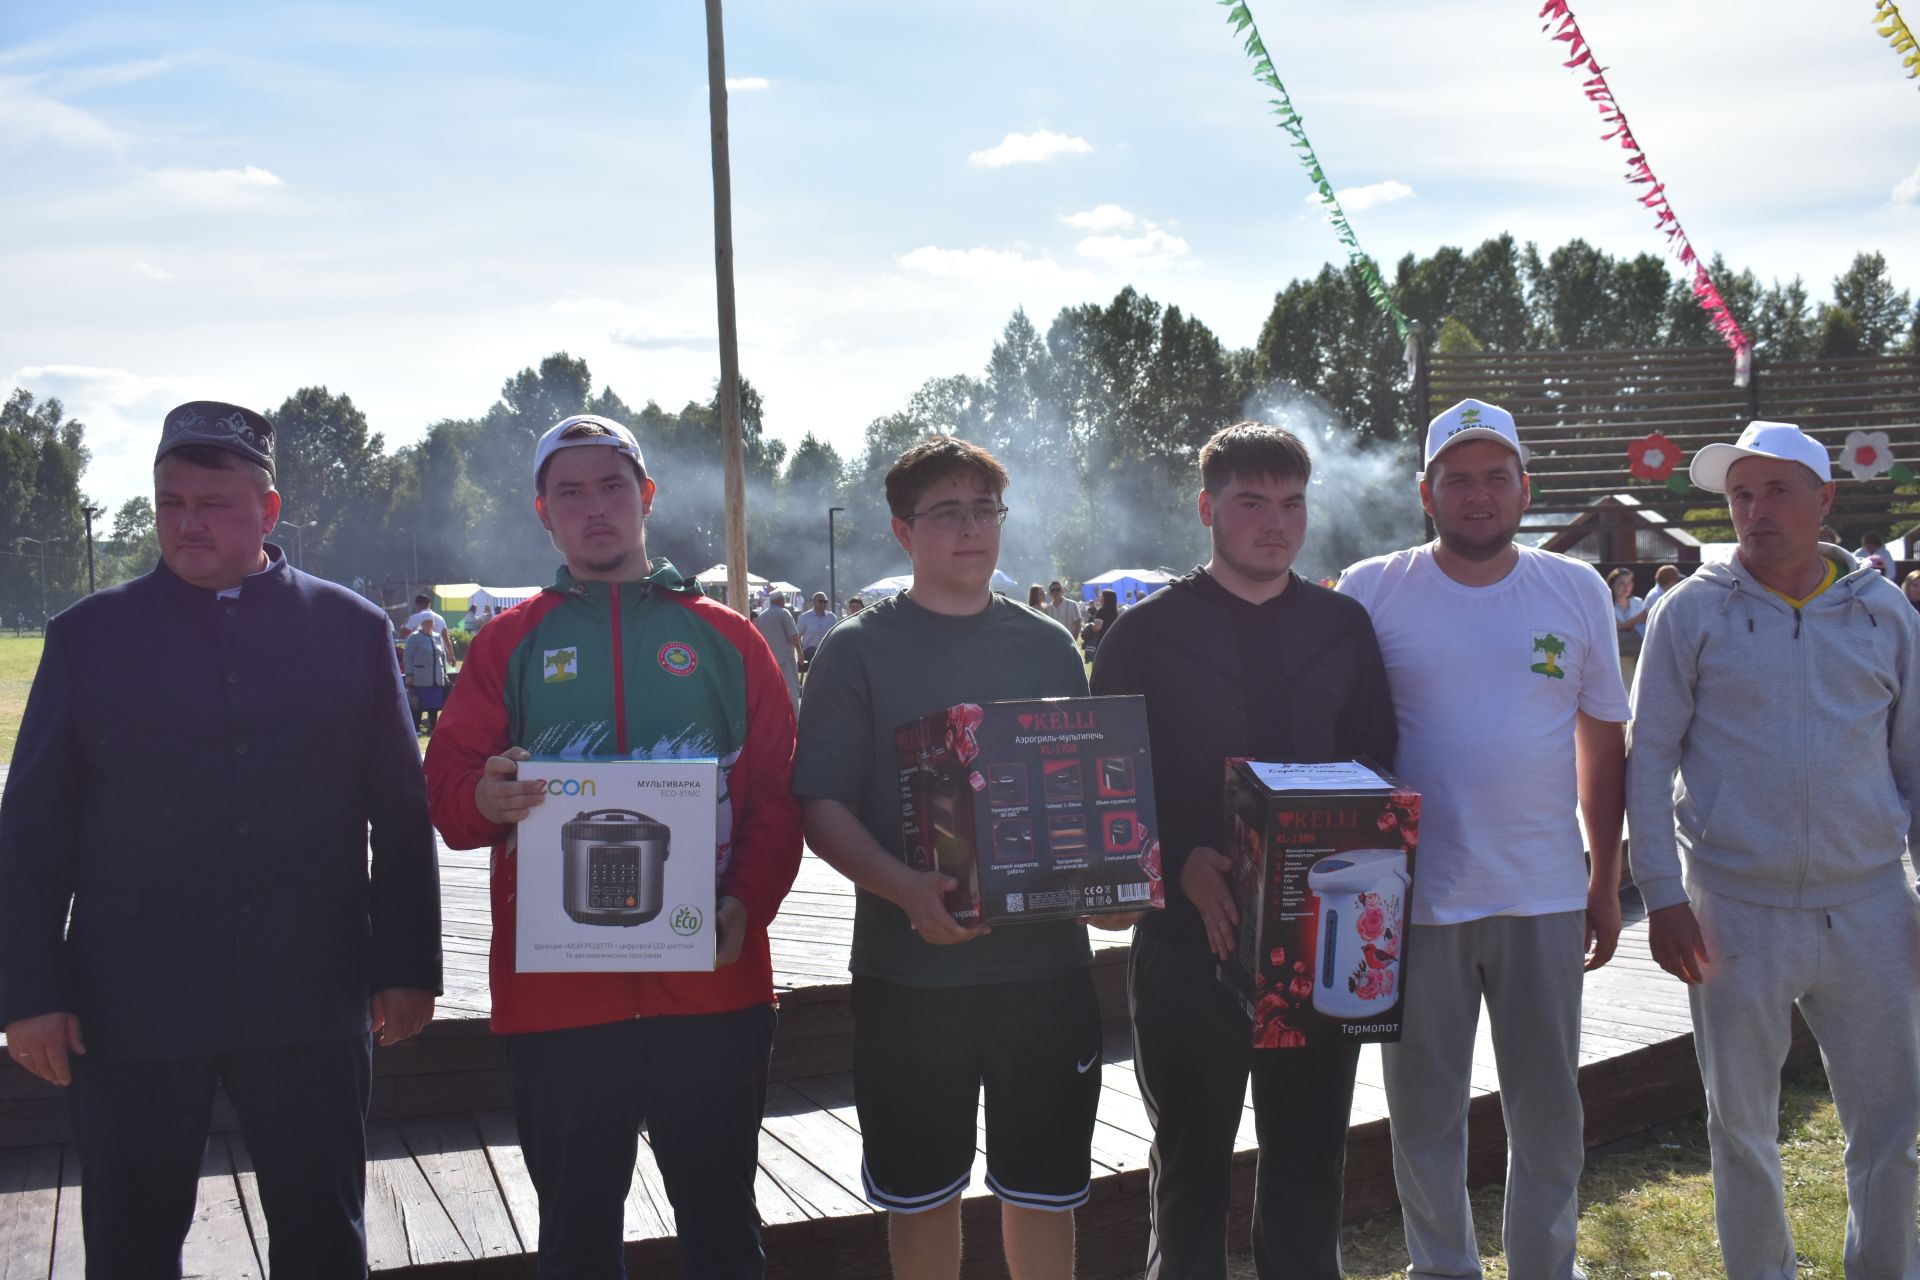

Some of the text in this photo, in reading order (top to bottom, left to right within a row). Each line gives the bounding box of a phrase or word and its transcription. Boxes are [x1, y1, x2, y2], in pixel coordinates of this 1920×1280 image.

[1034, 709, 1096, 730] KELLI
[1015, 732, 1104, 744] Аэрогриль-мультипечь
[637, 780, 701, 788] МУЛЬТИВАРКА
[1295, 810, 1359, 828] KELLI
[675, 914, 697, 930] ECO
[1341, 1023, 1399, 1036] Термопот
